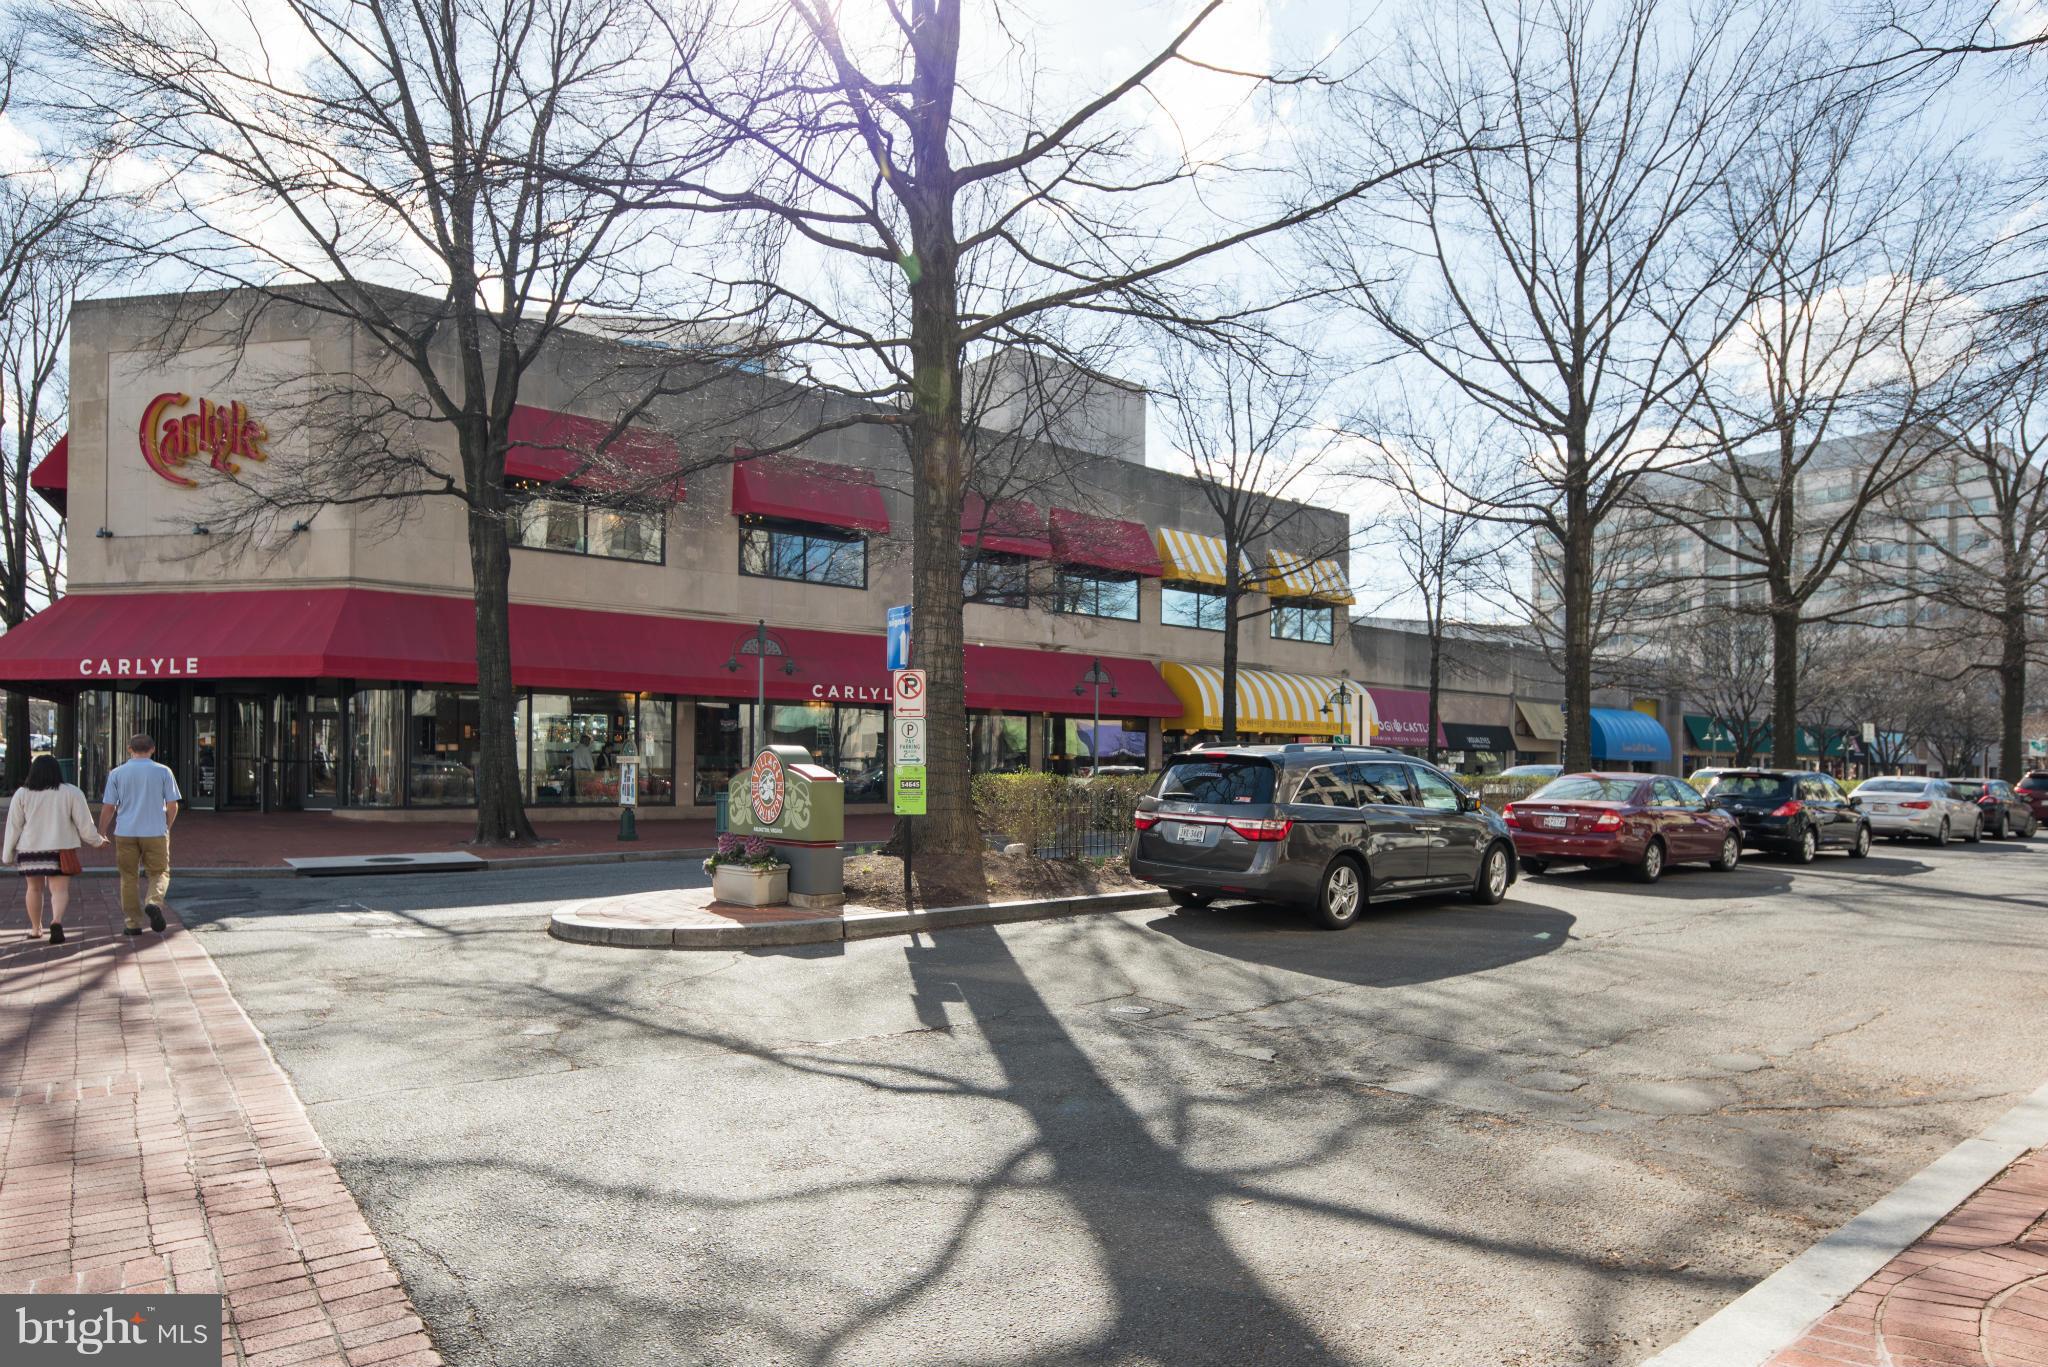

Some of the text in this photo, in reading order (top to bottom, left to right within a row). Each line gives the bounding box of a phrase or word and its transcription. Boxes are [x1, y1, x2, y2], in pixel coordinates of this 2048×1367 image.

[139, 392, 268, 488] Carlyle
[80, 657, 198, 675] CARLYLE
[812, 684, 893, 700] CARLYL
[1378, 720, 1394, 732] OGI
[752, 755, 783, 778] VILLAGE
